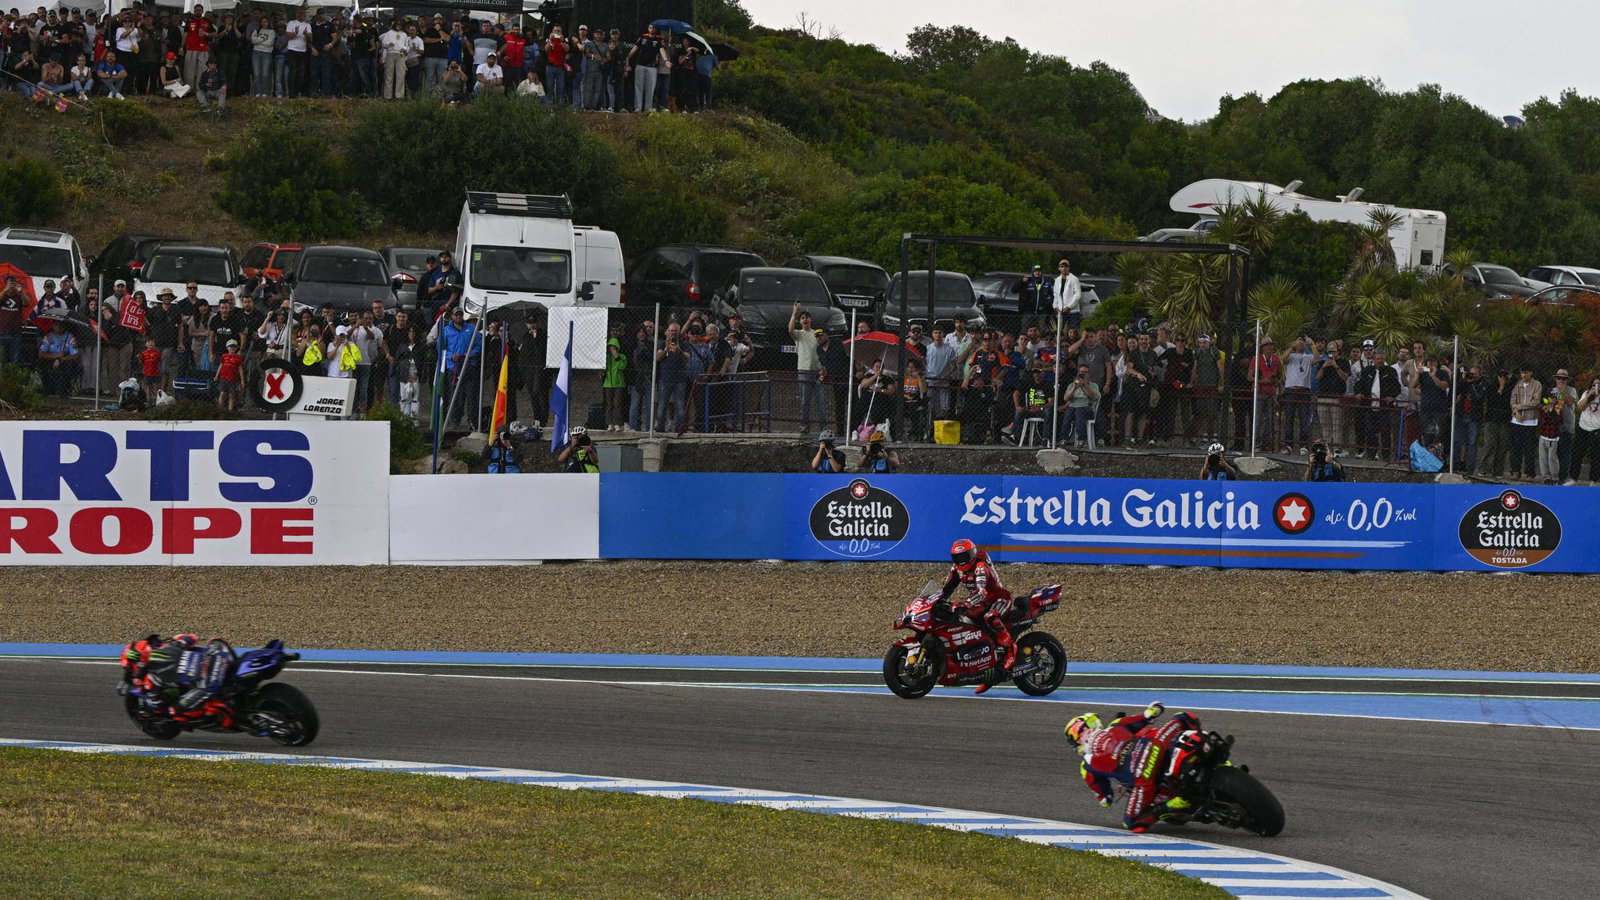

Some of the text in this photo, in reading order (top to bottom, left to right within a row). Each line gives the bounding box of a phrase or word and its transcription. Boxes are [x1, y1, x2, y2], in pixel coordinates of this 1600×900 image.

[303, 404, 342, 414] LORENZO
[316, 397, 345, 406] JORGE
[0, 430, 314, 502] RTS
[826, 500, 893, 519] Estrella
[960, 485, 1113, 527] Estrella
[1121, 488, 1261, 531] Galicia
[1347, 497, 1393, 532] 0,0
[828, 518, 890, 537] Galicia
[1476, 510, 1543, 530] Estrella
[849, 538, 870, 554] 0,0
[1478, 529, 1540, 548] Galicia
